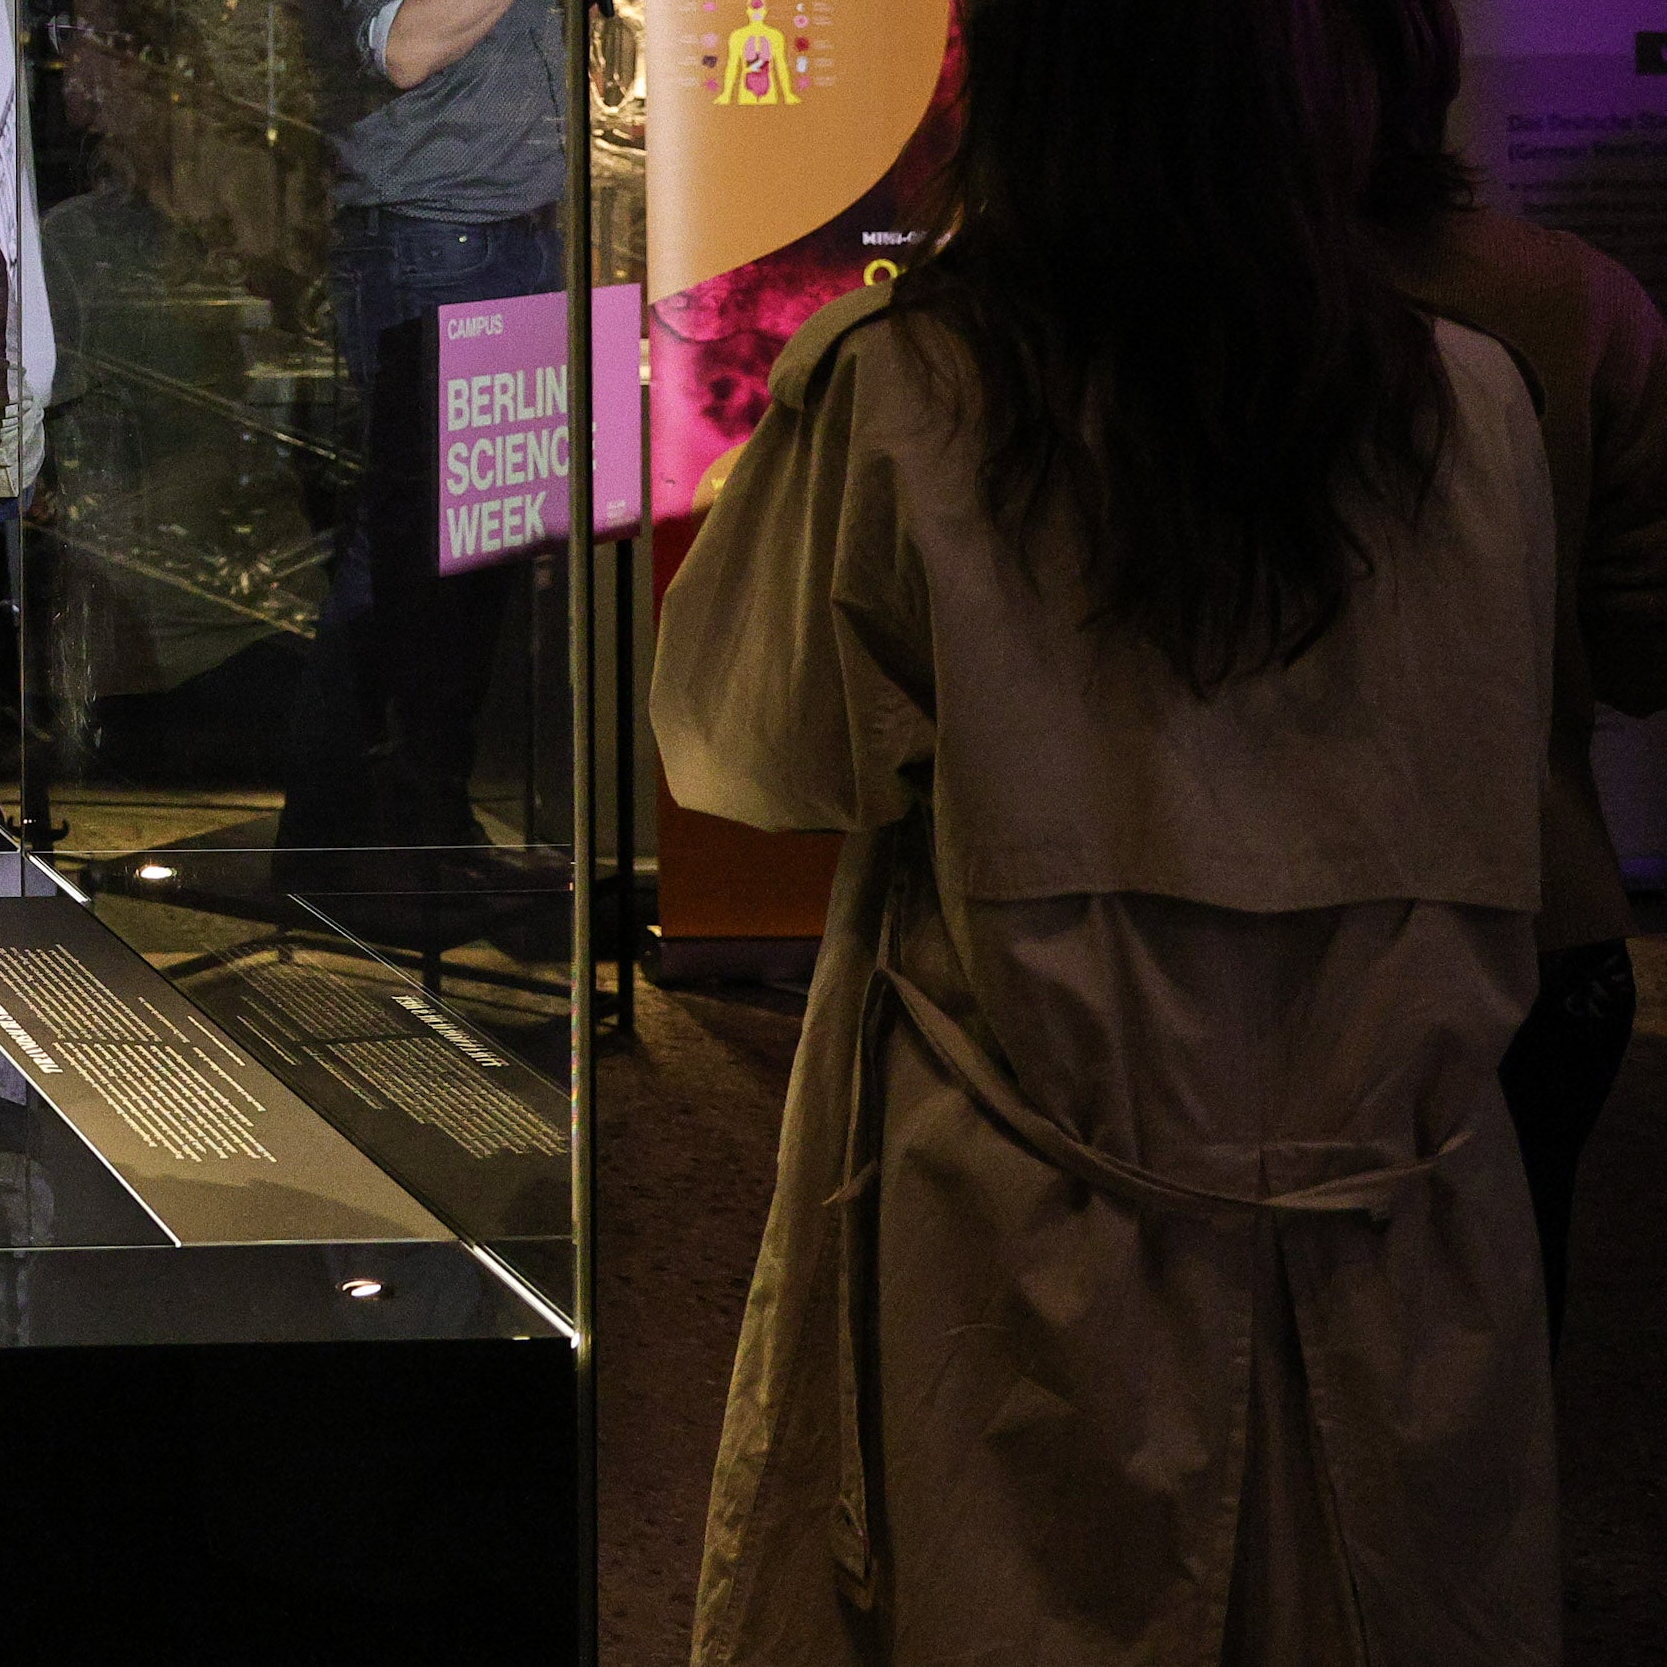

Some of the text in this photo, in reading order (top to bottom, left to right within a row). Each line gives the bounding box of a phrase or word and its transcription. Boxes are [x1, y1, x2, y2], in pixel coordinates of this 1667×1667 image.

[447, 314, 504, 340] CAMPUS
[447, 364, 568, 432] BERLIN
[447, 422, 597, 496] SCIENC
[446, 491, 547, 559] WEEK
